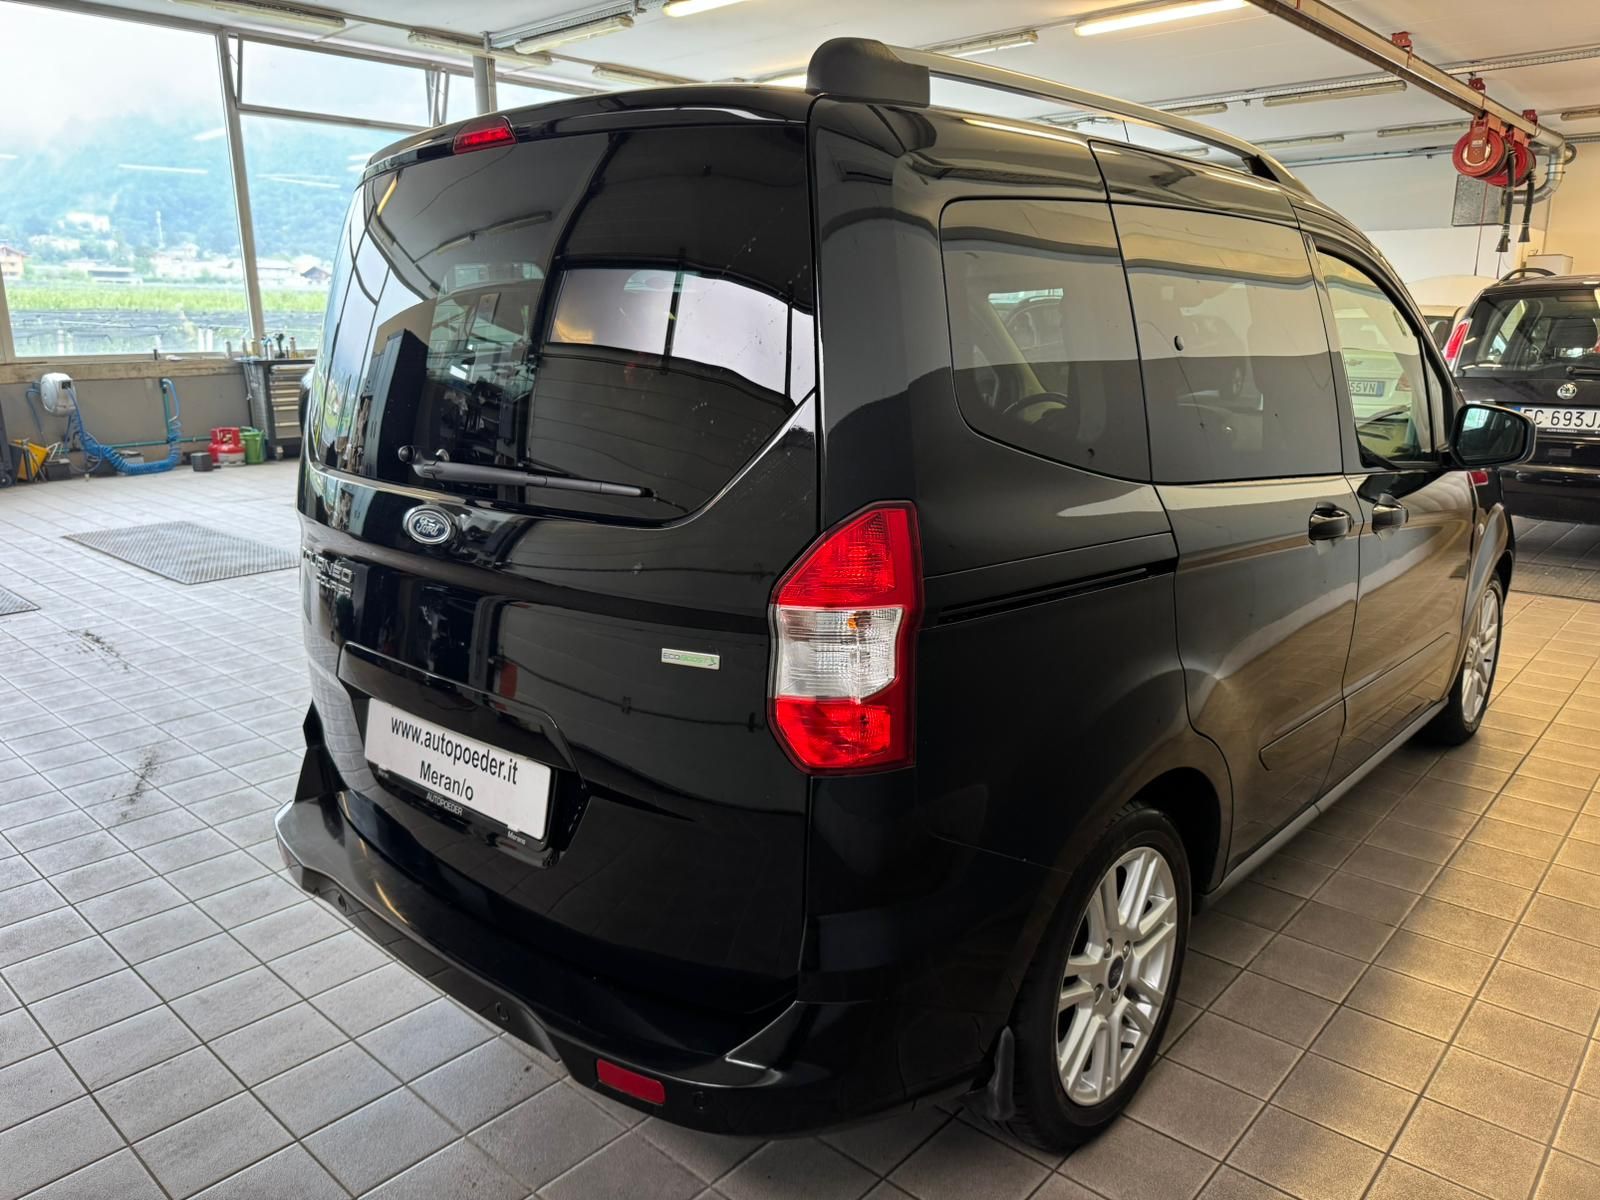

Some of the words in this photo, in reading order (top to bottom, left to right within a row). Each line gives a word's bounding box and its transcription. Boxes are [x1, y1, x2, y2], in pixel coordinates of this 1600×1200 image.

[1551, 410, 1600, 428] 693J
[391, 717, 518, 785] www.autopoeder.it
[419, 760, 474, 801] Meran/o
[426, 792, 464, 816] AUTOPOEDER
